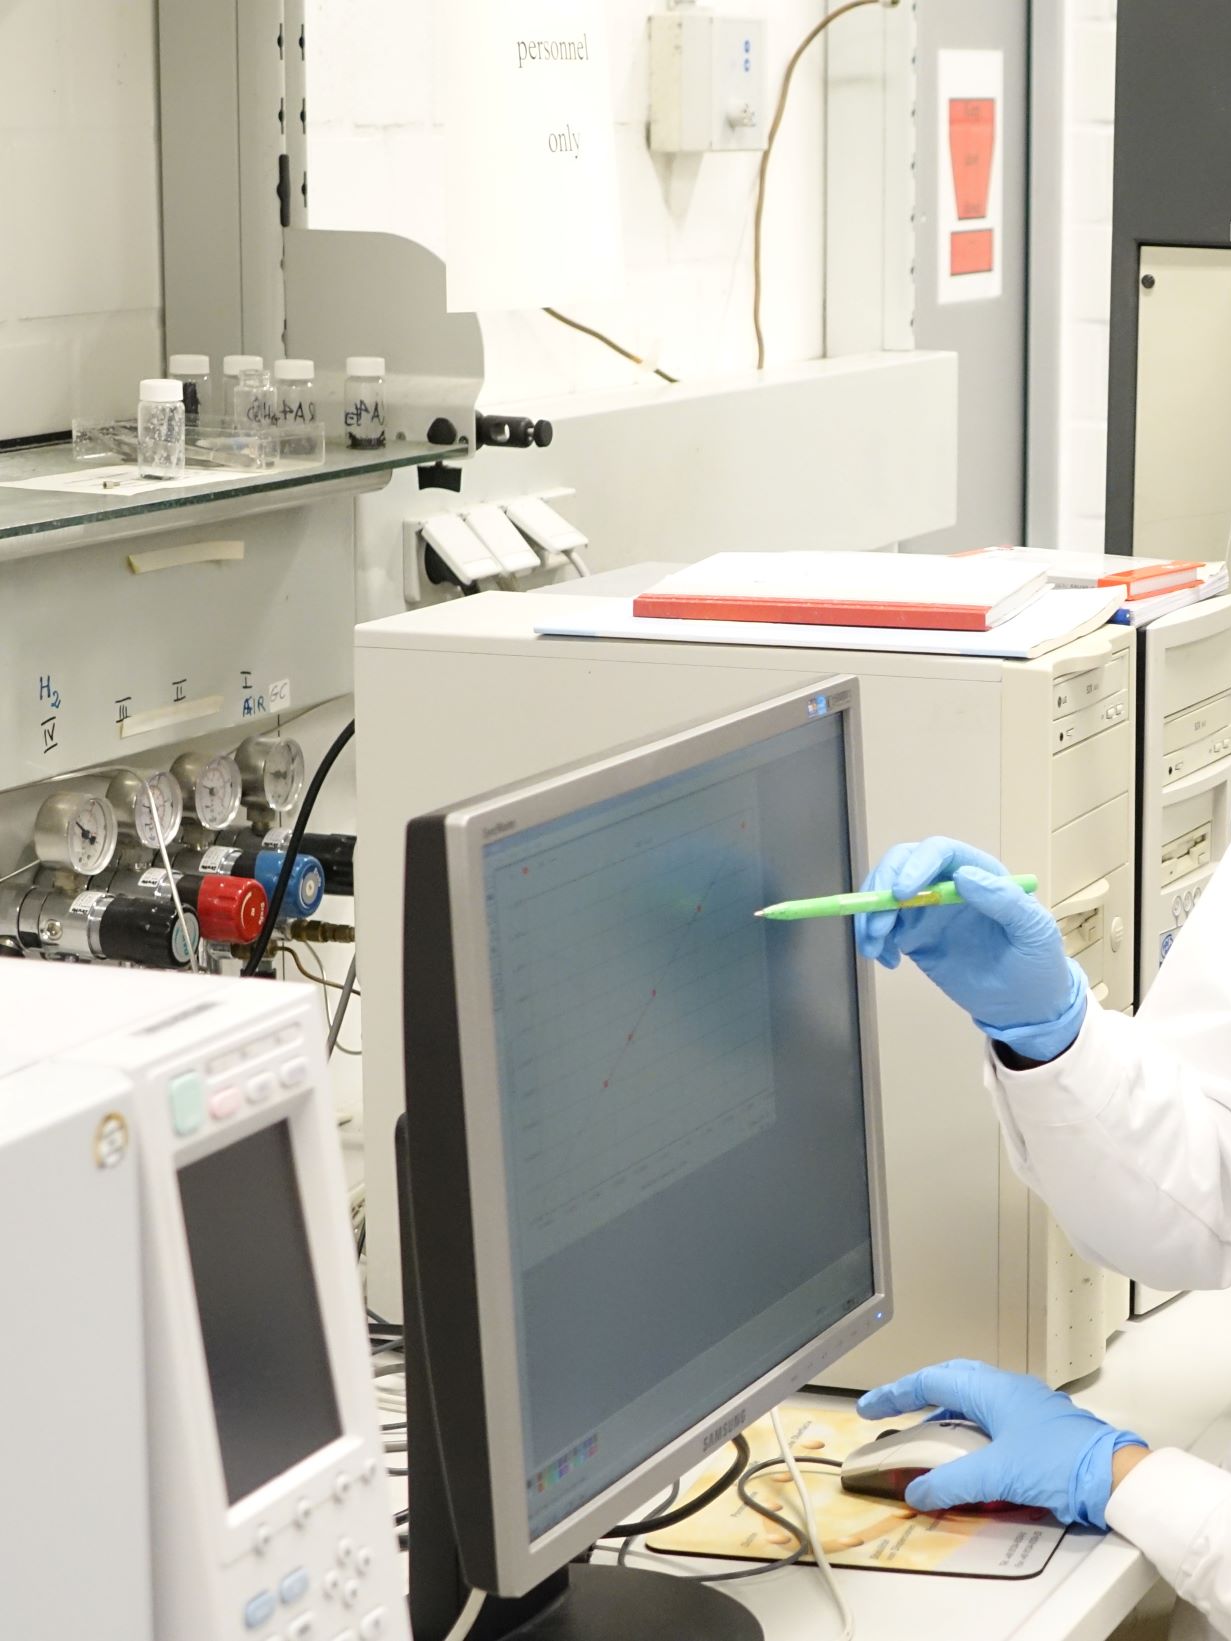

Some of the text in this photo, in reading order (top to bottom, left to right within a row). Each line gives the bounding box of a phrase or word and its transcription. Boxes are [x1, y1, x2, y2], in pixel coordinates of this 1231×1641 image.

[516, 32, 589, 68] personnel
[548, 123, 579, 159] only
[702, 1408, 746, 1453] SAMSUNG
